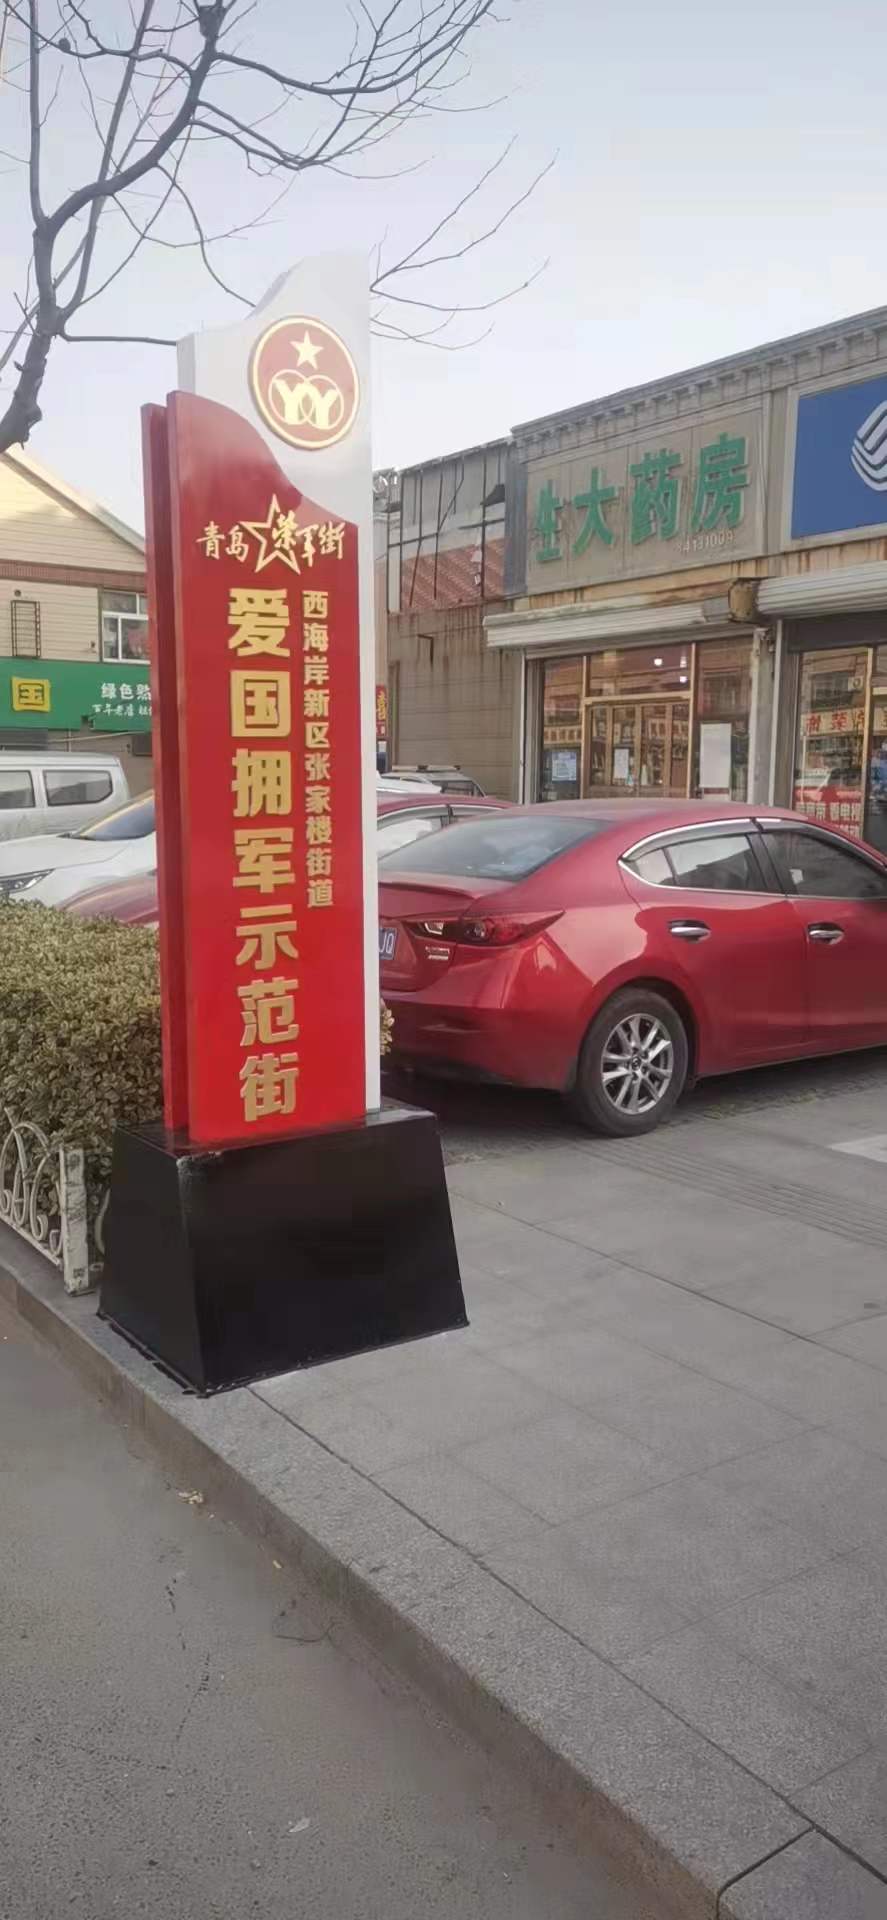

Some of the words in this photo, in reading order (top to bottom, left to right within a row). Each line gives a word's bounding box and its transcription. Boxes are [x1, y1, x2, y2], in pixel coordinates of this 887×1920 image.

[536, 432, 748, 562] 生大药房
[228, 588, 299, 1122] 爱国拥军示范街
[302, 590, 334, 908] 西海岸新区张家楼街道
